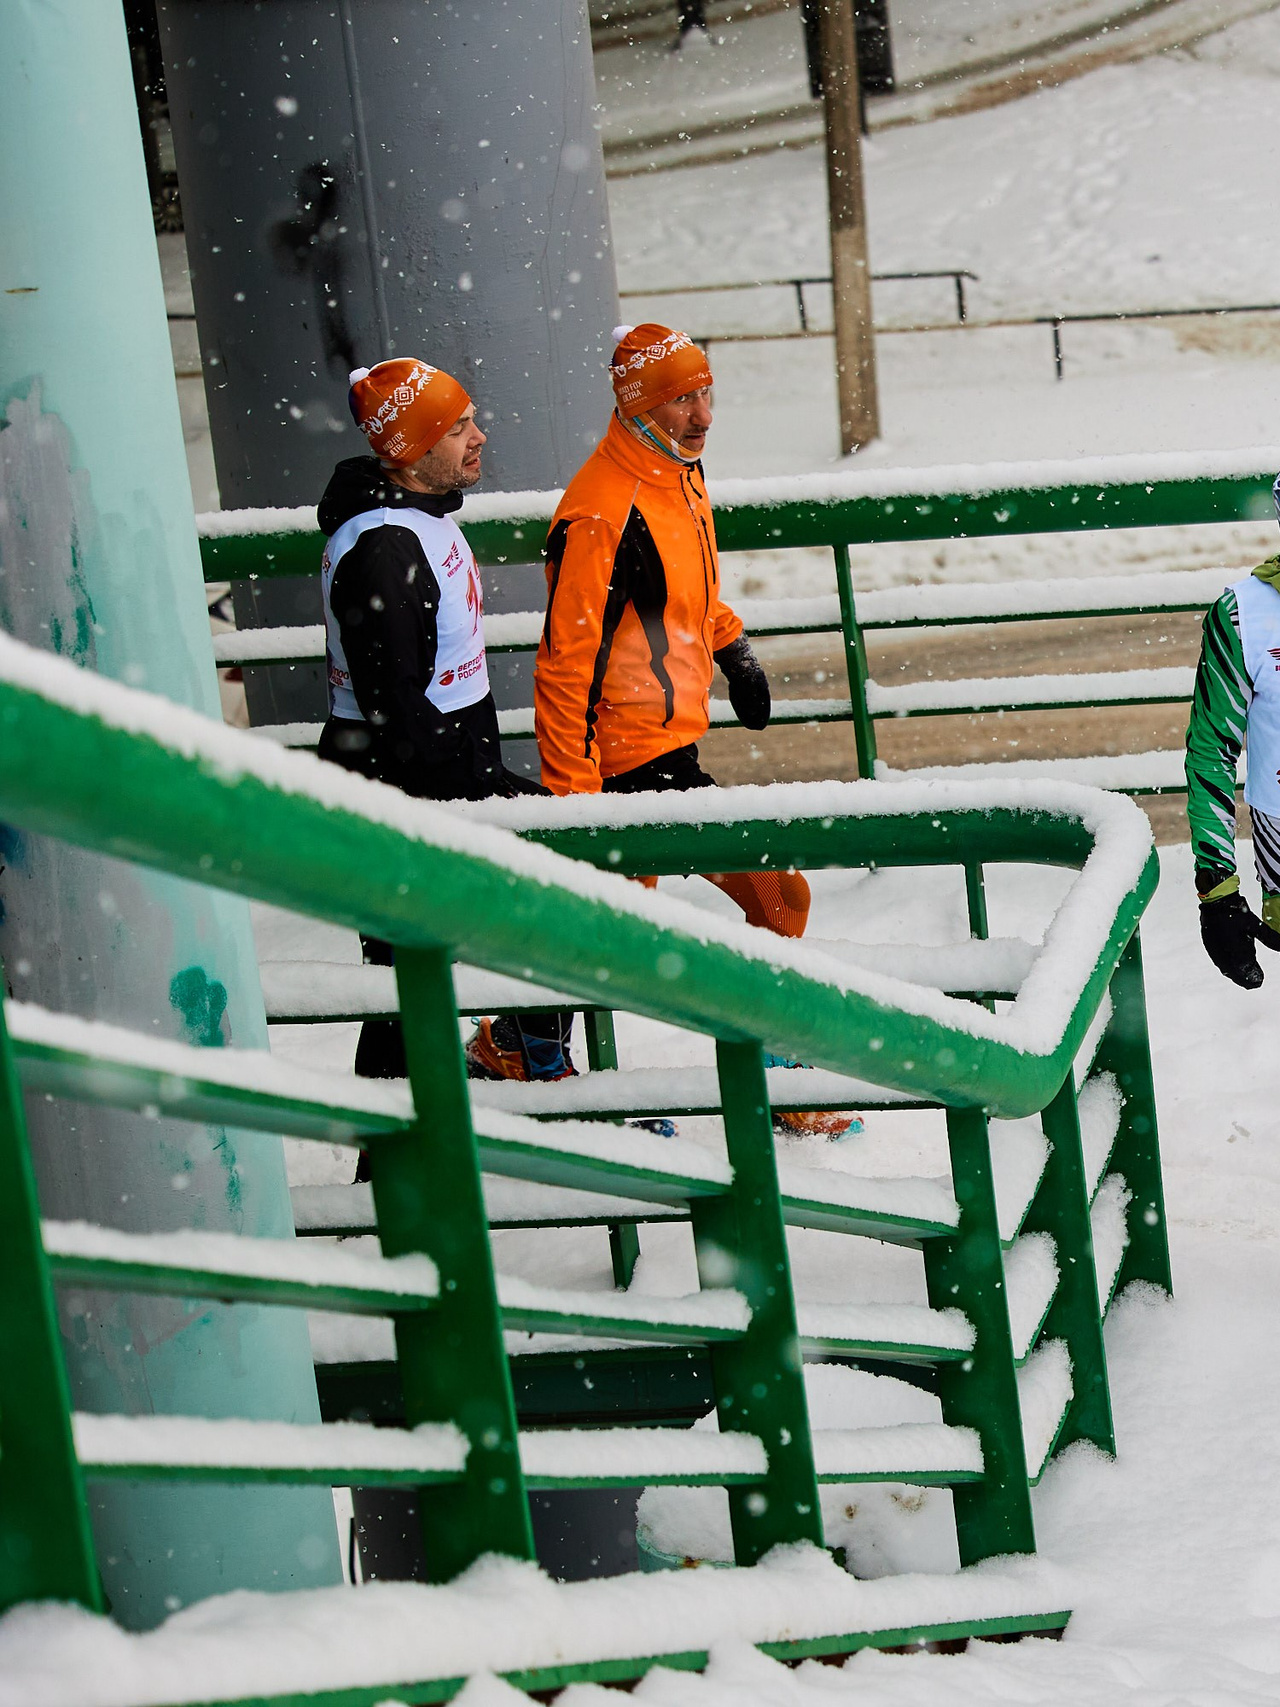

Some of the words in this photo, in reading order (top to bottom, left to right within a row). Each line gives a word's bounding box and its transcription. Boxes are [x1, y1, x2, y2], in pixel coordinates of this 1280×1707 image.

[630, 379, 643, 391] FOX
[622, 389, 642, 403] ULTRA
[391, 431, 405, 444] FOX
